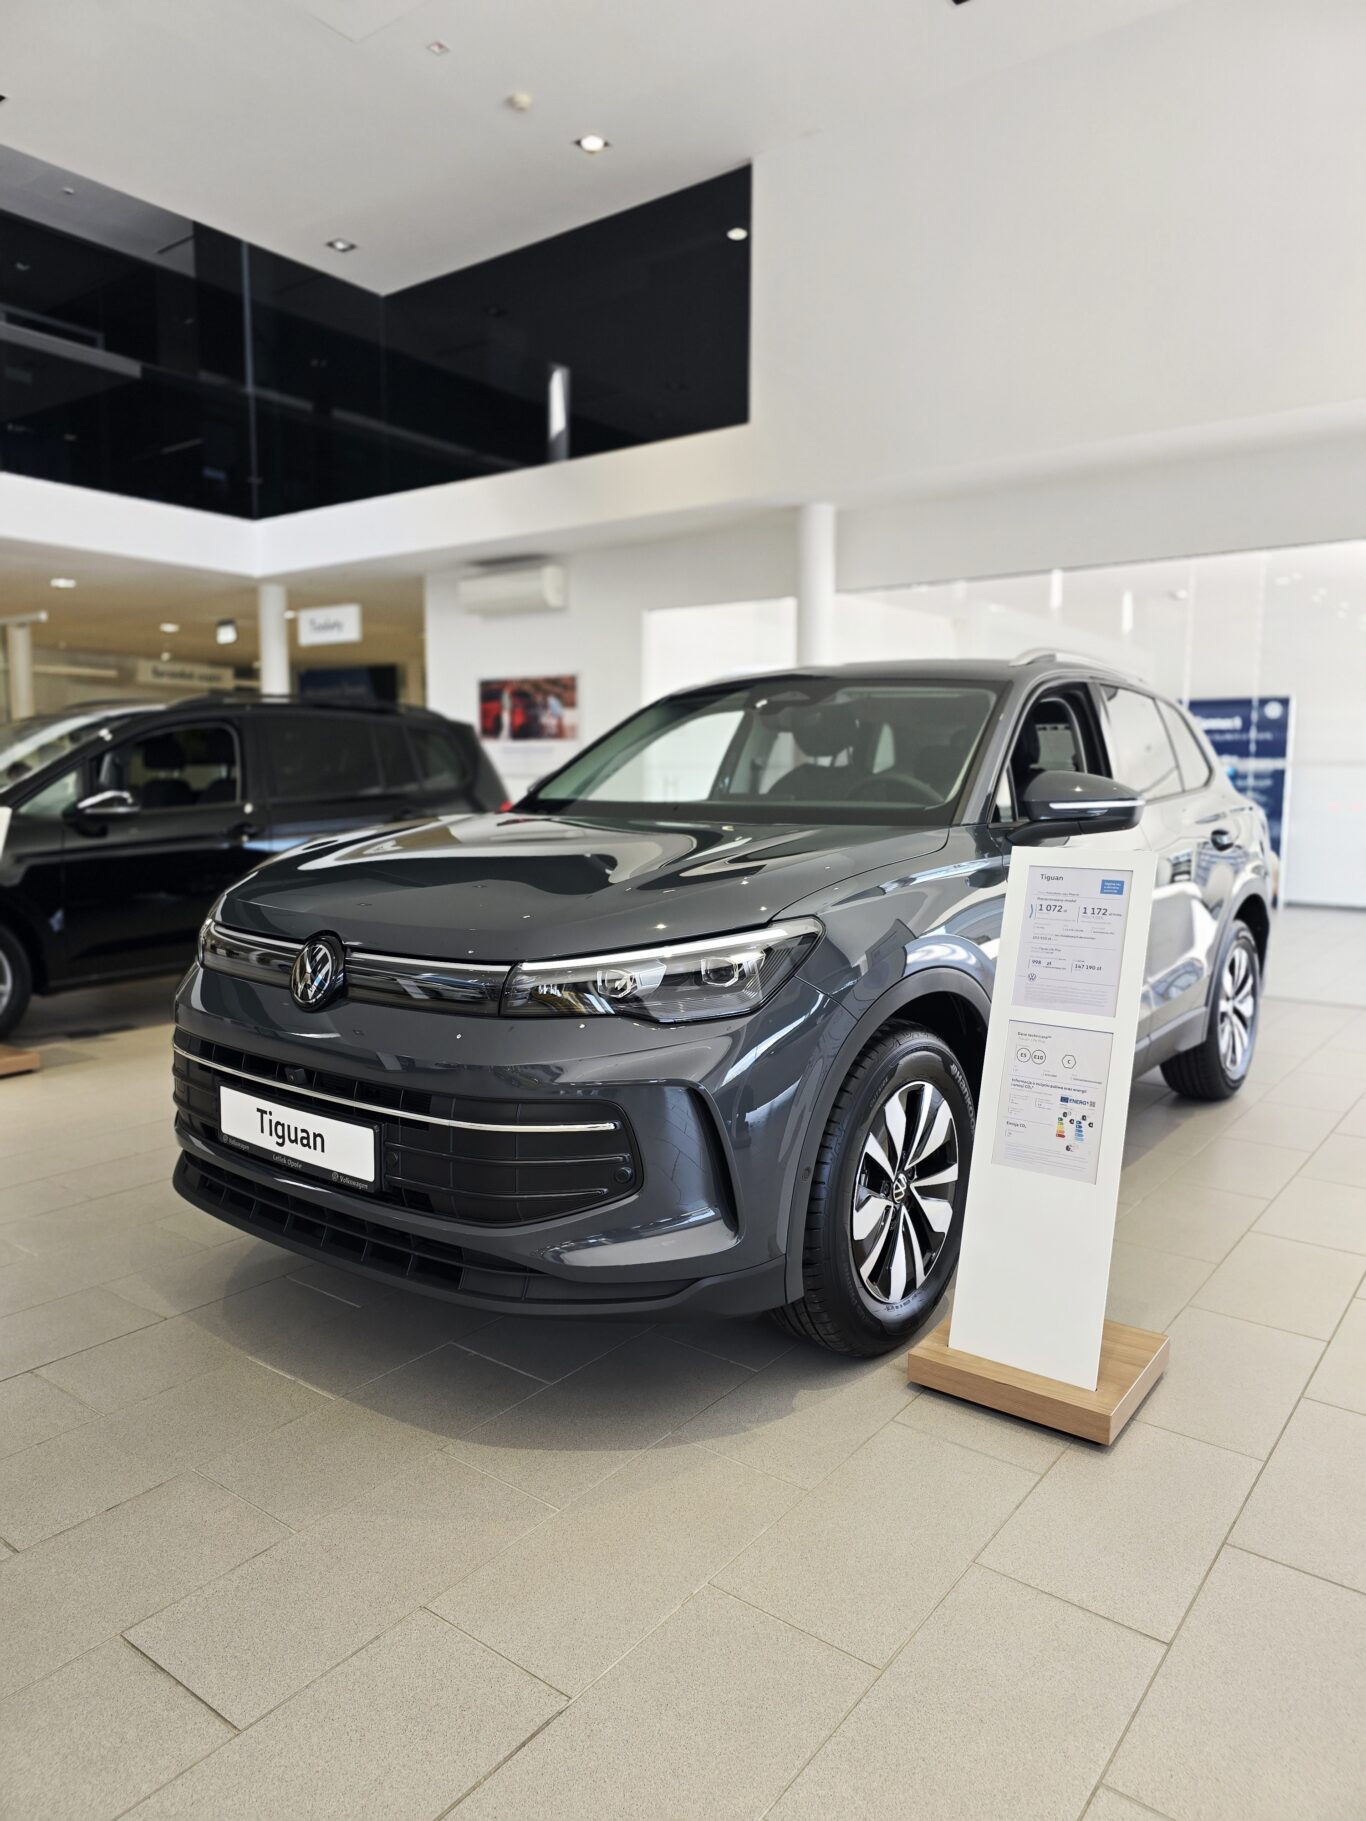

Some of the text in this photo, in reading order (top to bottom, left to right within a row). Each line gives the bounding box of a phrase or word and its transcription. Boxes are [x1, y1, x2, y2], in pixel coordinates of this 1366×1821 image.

[1040, 873, 1064, 882] Tiguan
[1045, 904, 1063, 912] 072
[1091, 907, 1108, 916] 172
[256, 1107, 325, 1153] Tiguan
[339, 1175, 369, 1190] Volkswagen
